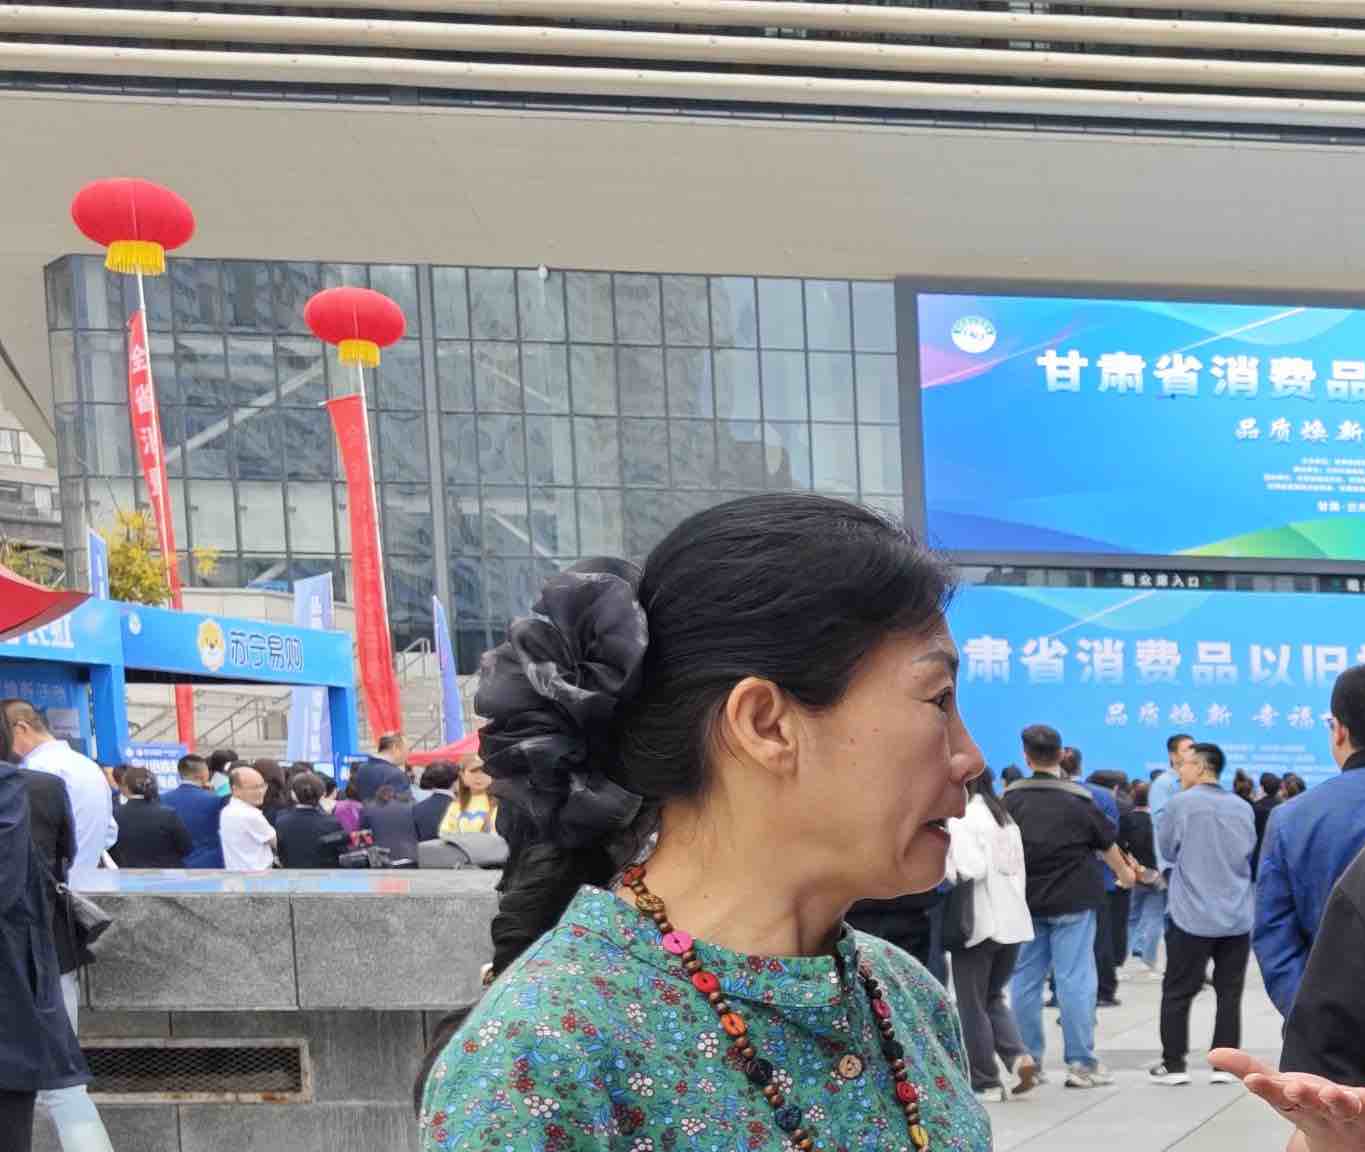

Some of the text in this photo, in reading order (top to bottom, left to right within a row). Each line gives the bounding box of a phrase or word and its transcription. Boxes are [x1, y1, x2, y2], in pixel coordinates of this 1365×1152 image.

[1235, 417, 1364, 443] 品质焕新
[230, 630, 304, 673] 苏宁易购
